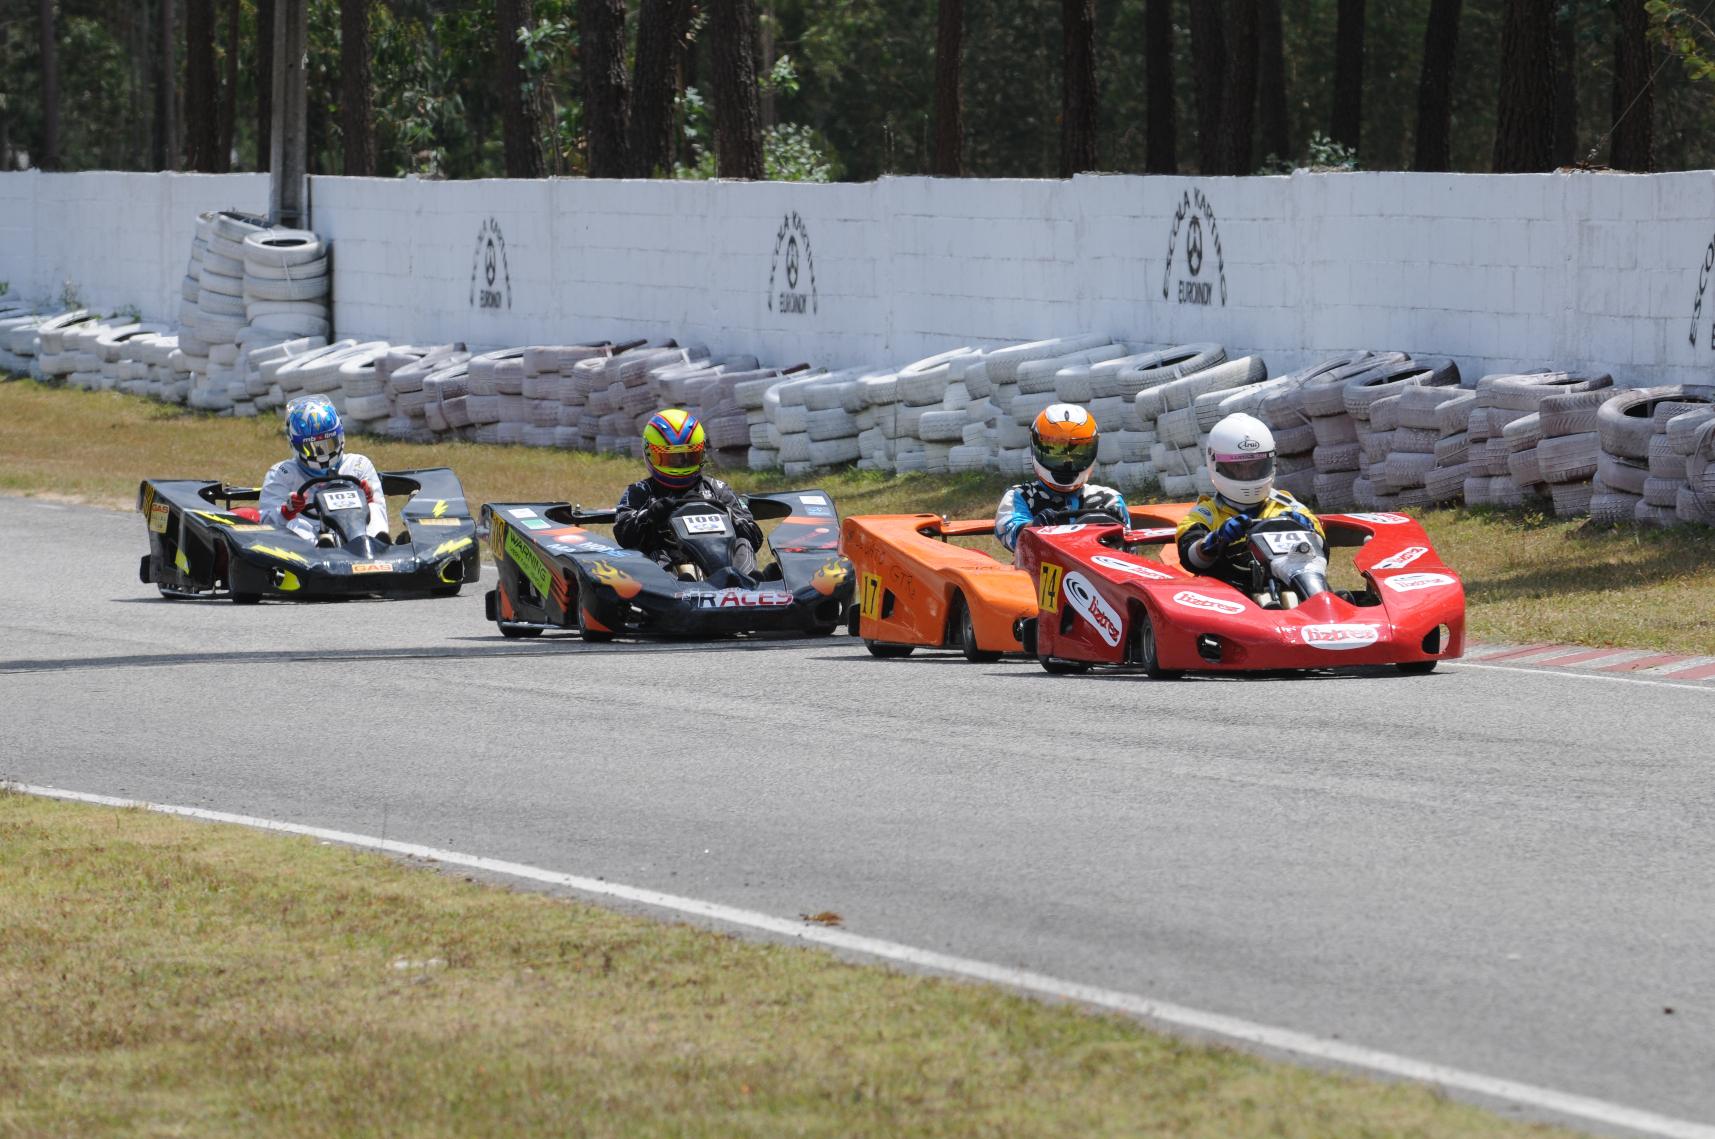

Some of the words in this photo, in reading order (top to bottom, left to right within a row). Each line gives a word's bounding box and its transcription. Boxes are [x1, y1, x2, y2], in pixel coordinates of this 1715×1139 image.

[1163, 190, 1190, 301] ESCOLA
[1194, 187, 1228, 307] KARTING
[1688, 233, 1715, 347] ESCO
[152, 503, 169, 514] GAS
[327, 491, 357, 501] 103
[509, 529, 548, 582] WARNING
[1269, 532, 1300, 543] 74
[353, 564, 393, 573] GAS
[1041, 565, 1058, 609] 74
[863, 575, 878, 615] 17
